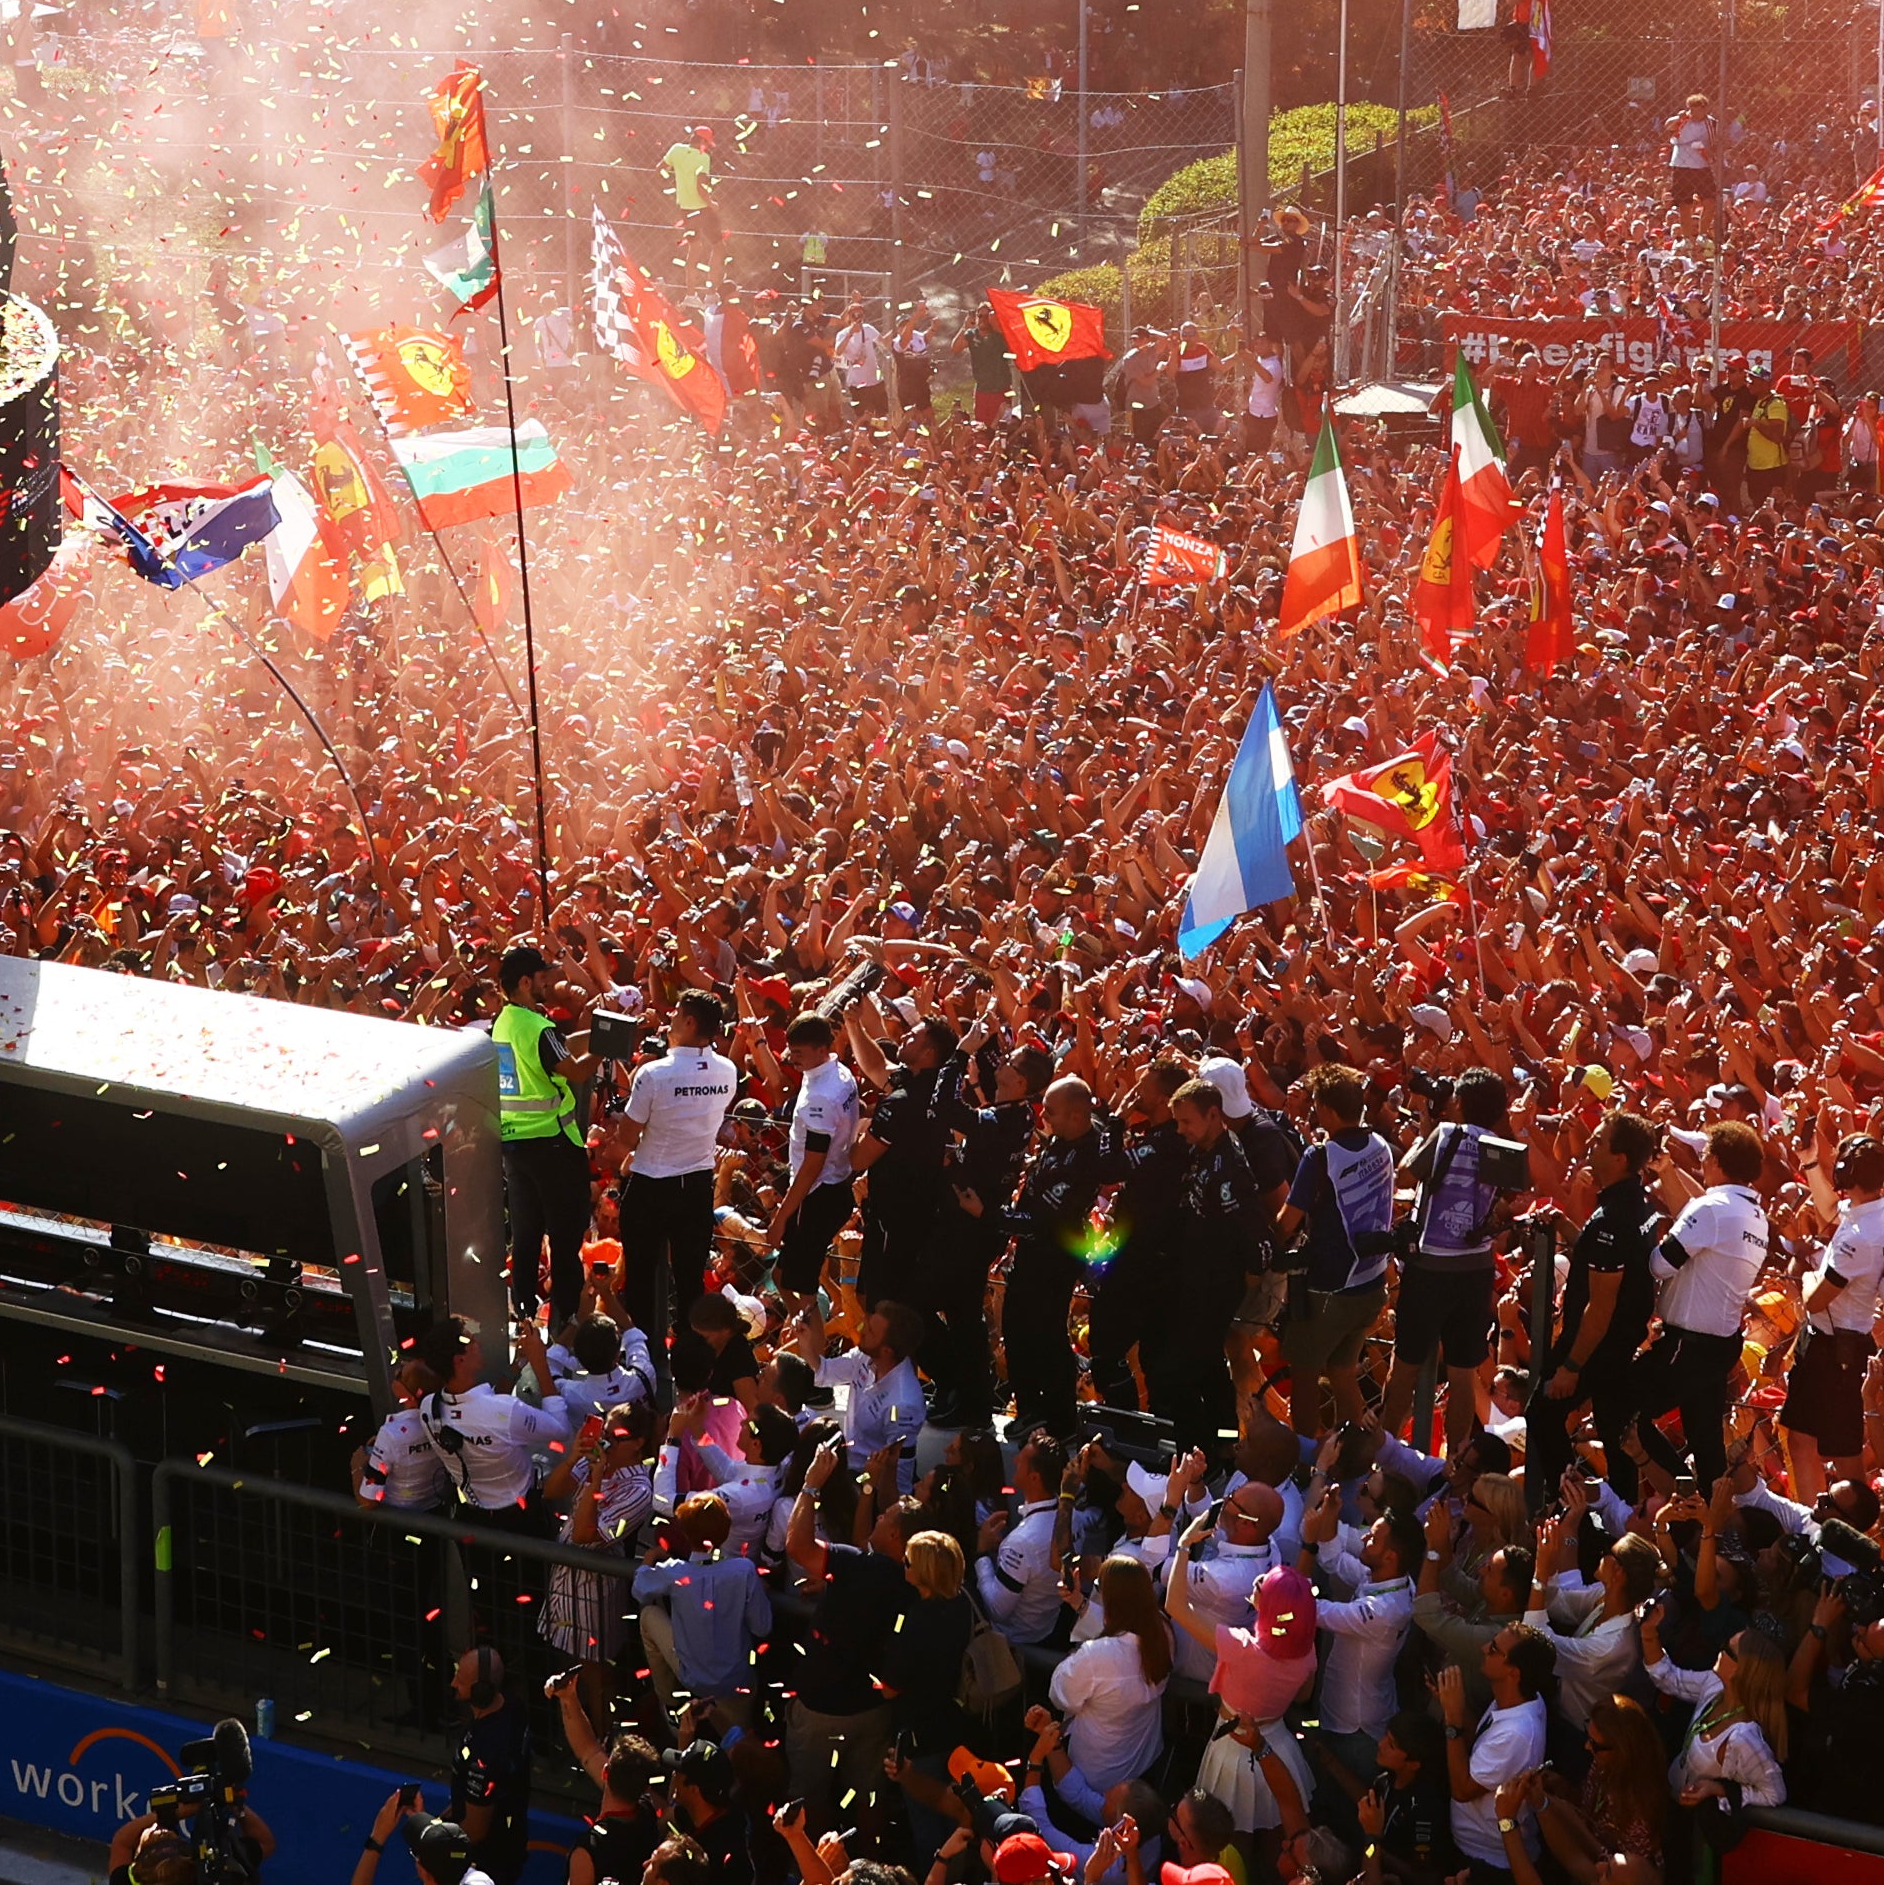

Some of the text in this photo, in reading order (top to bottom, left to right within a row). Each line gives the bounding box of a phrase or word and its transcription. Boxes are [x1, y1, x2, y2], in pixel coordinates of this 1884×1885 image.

[1163, 531, 1214, 557] MONZA
[674, 1083, 730, 1098] PETRONAS
[11, 1759, 141, 1821] work
